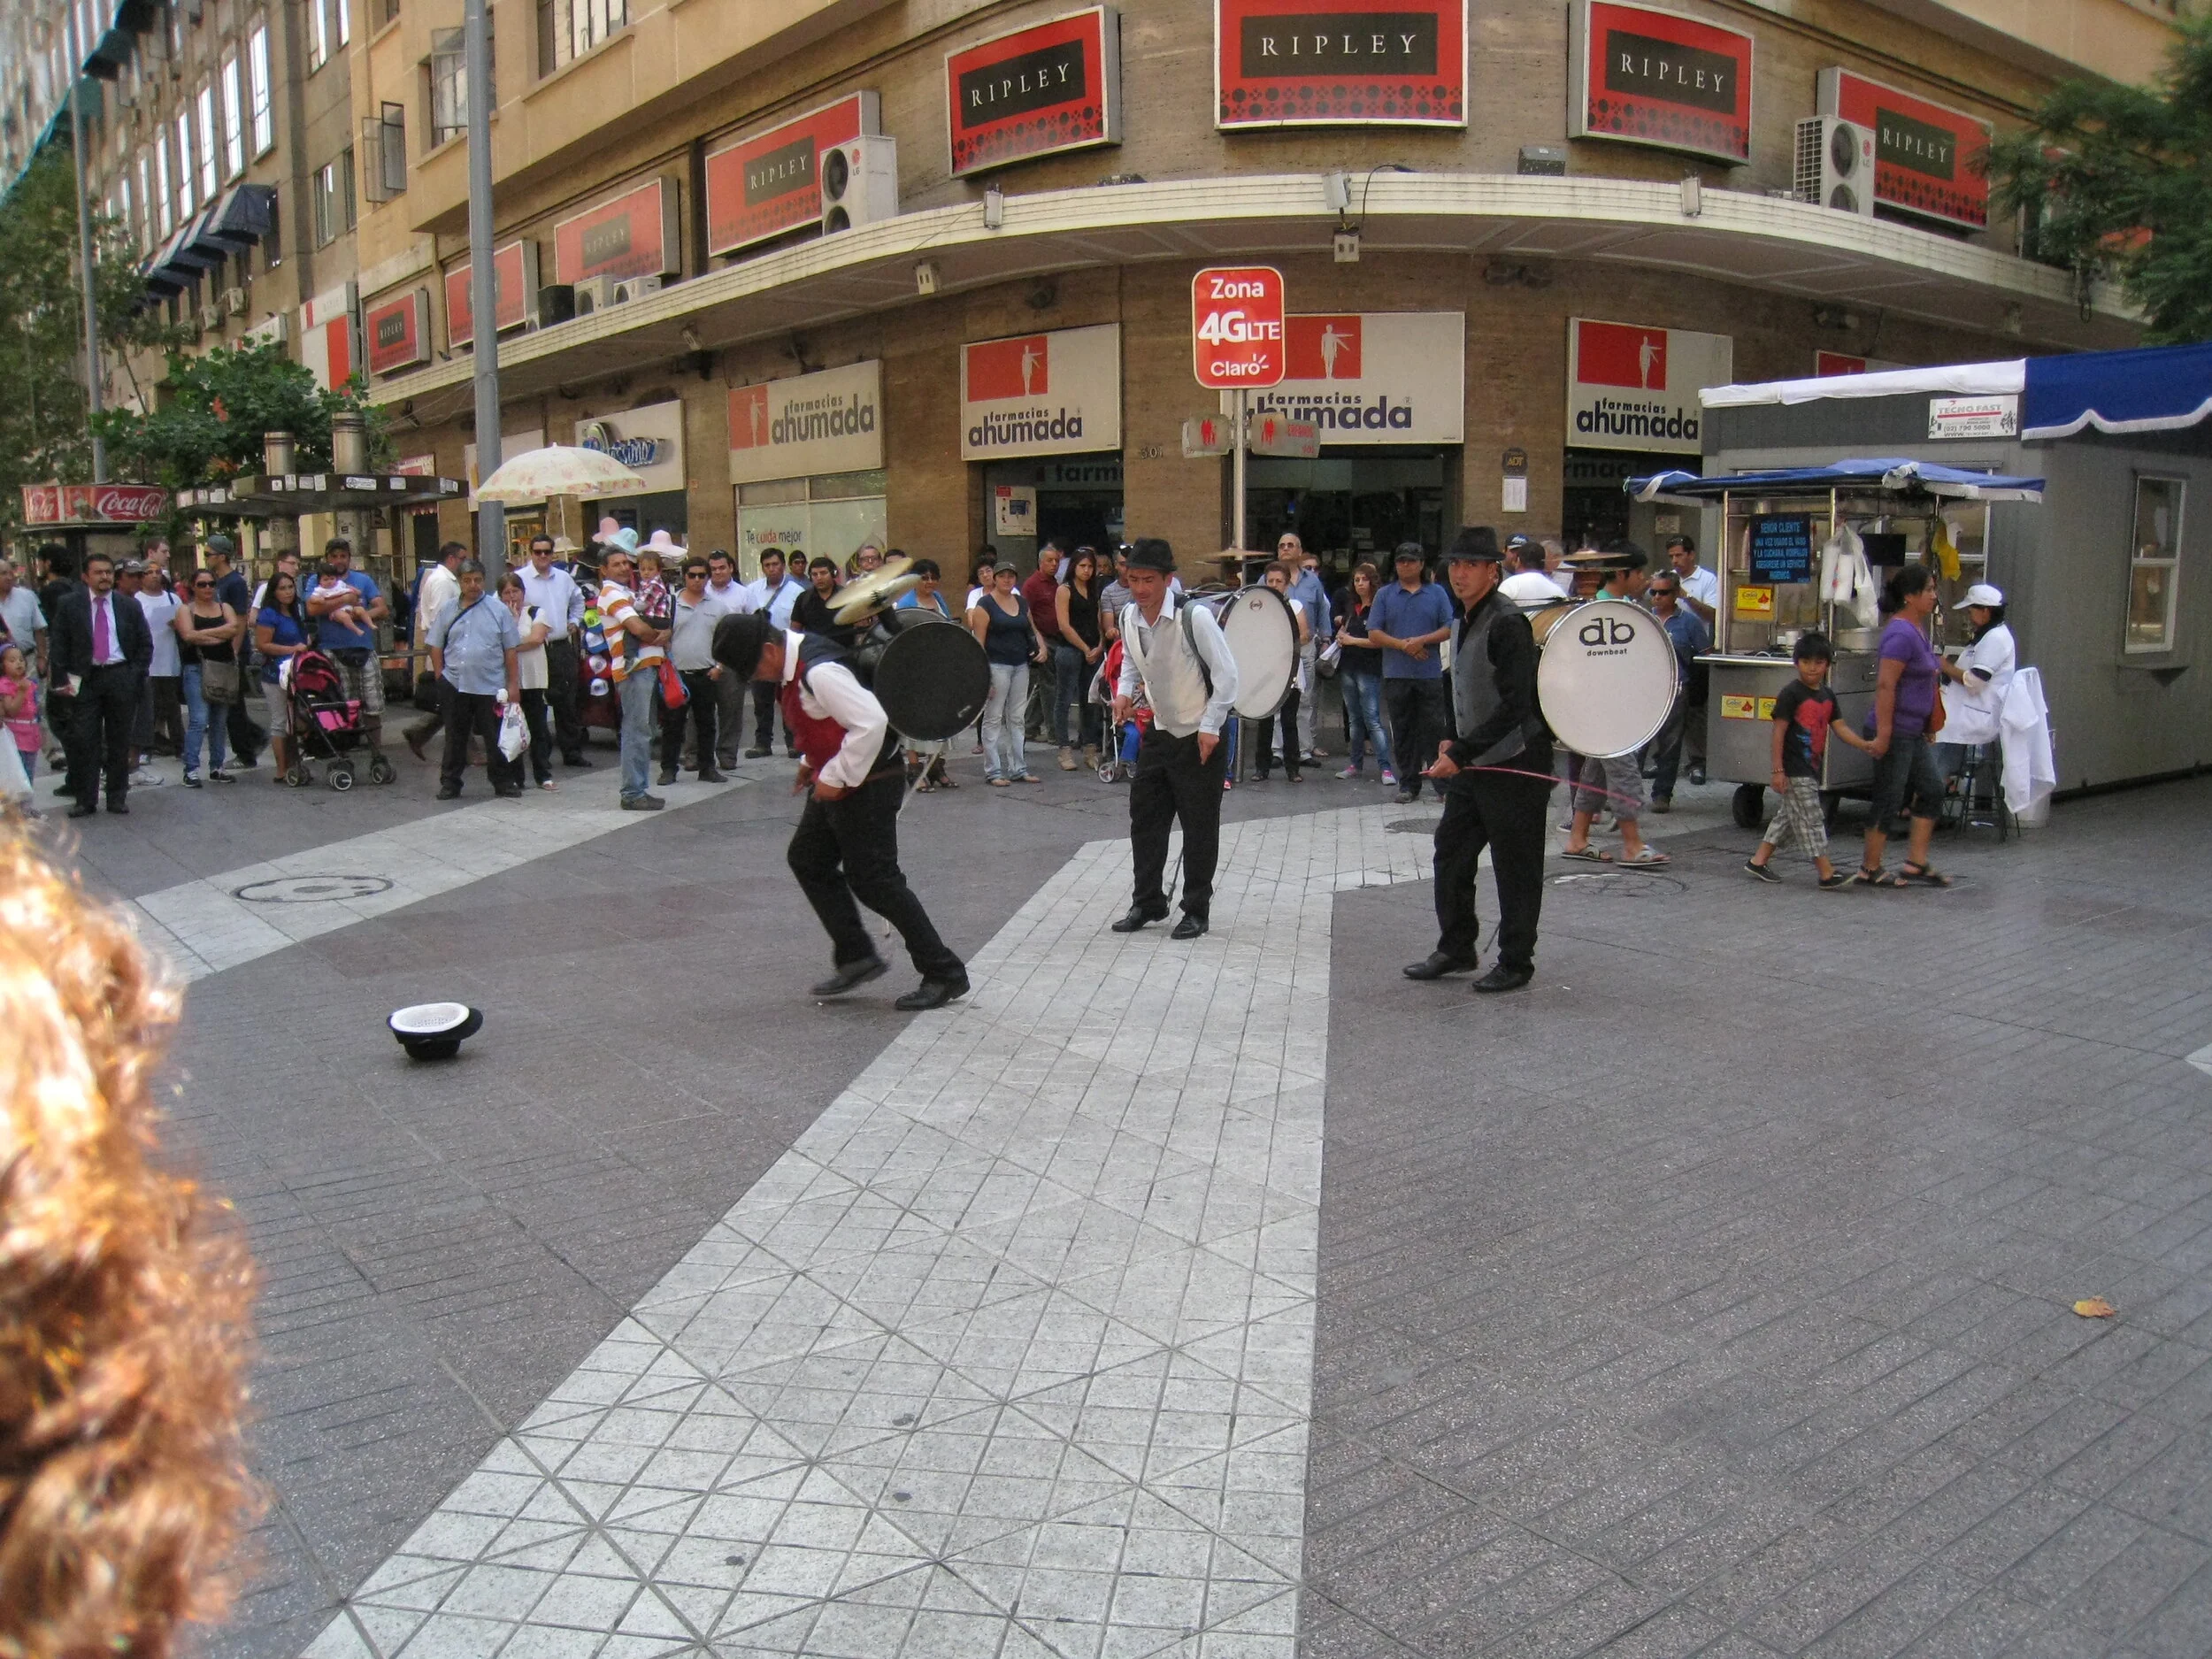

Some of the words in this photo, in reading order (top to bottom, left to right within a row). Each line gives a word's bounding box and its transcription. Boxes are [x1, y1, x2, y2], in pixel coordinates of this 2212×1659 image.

[1261, 35, 1416, 57] RIPLEY
[1620, 53, 1724, 93] RIPLEY
[971, 62, 1069, 107] RIPLEY
[1883, 127, 1947, 163] RIPLEY
[749, 154, 808, 190] RIPLEY
[1210, 278, 1264, 299] Zona
[379, 320, 403, 339] RIPLEY
[1197, 311, 1247, 346] 4G
[1210, 357, 1263, 377] Claro
[789, 393, 843, 414] farmacias
[1267, 391, 1362, 405] farmacias
[1601, 396, 1666, 414] farmacias
[772, 393, 874, 444] ahumada
[989, 406, 1049, 423] farmacias
[1576, 400, 1699, 440] ahumada
[968, 407, 1083, 447] ahumada
[746, 530, 755, 544] Te
[756, 529, 777, 544] cuida
[778, 530, 802, 546] mejor
[1578, 617, 1636, 647] db
[1586, 648, 1628, 657] downbeat
